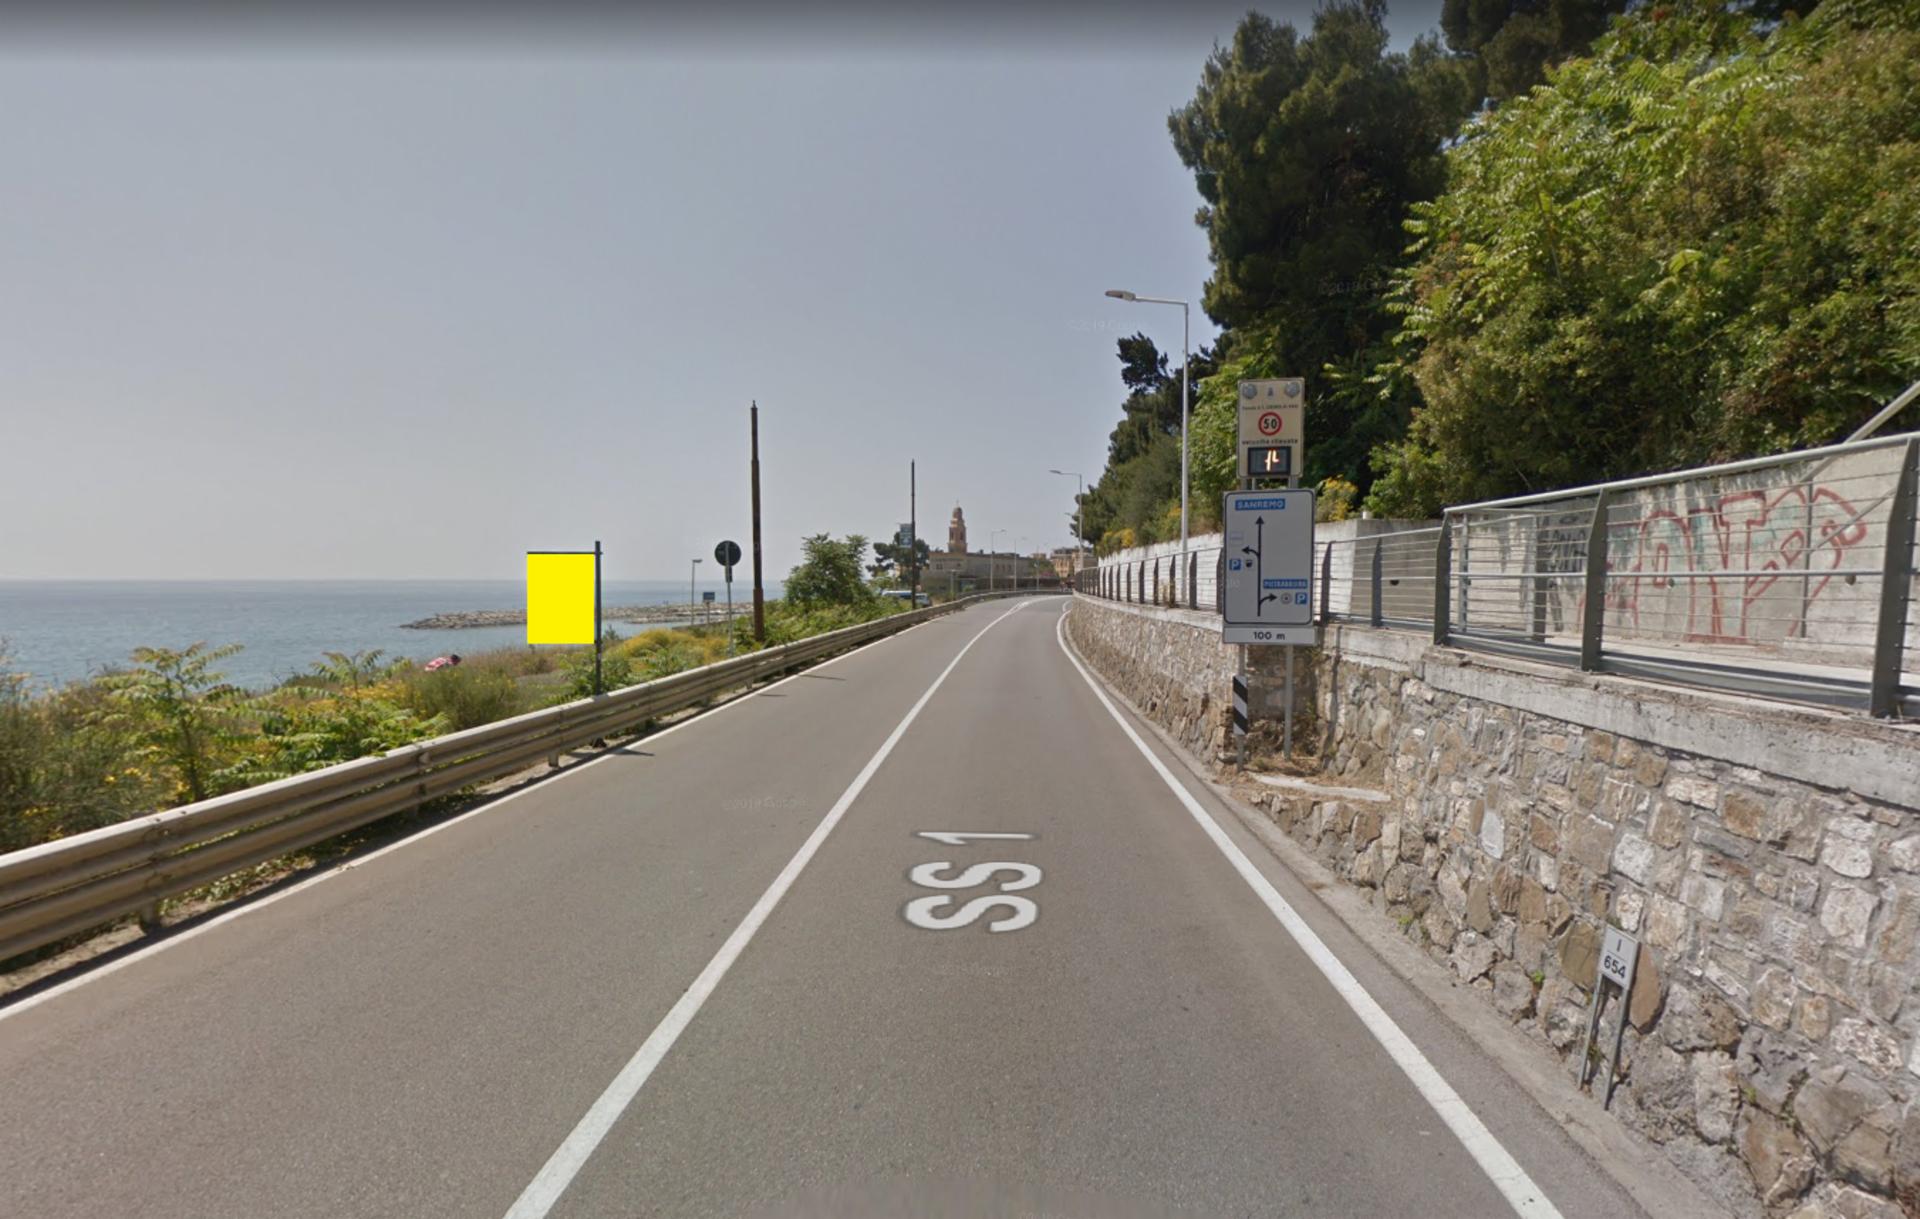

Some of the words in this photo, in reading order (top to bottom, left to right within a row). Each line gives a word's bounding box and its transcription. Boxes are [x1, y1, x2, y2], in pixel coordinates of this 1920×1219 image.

[1263, 418, 1278, 430] 50
[1237, 500, 1284, 509] SANREMO
[1231, 559, 1240, 570] P
[1296, 593, 1305, 604] P
[1253, 631, 1272, 640] 100
[1604, 955, 1626, 979] 654
